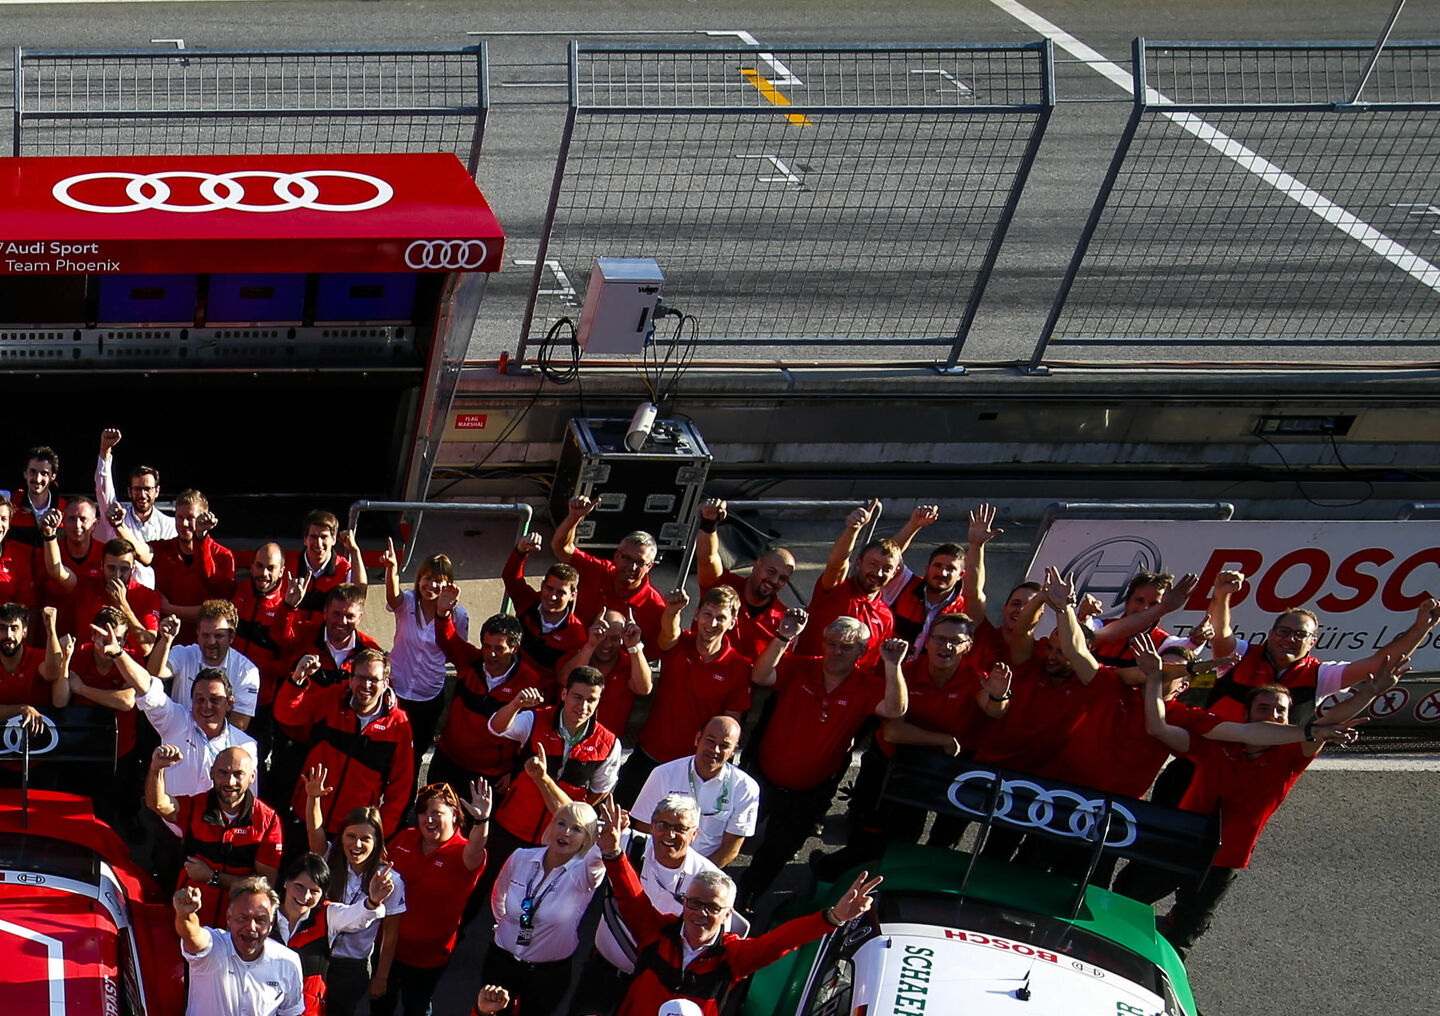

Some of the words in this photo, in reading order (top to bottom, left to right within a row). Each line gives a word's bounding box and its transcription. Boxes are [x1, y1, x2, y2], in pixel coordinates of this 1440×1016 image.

[5, 242, 44, 254] Audi
[50, 242, 99, 257] Sport
[5, 259, 50, 271] Team
[55, 259, 120, 271] Phoenix
[944, 930, 1058, 963] BOSCH
